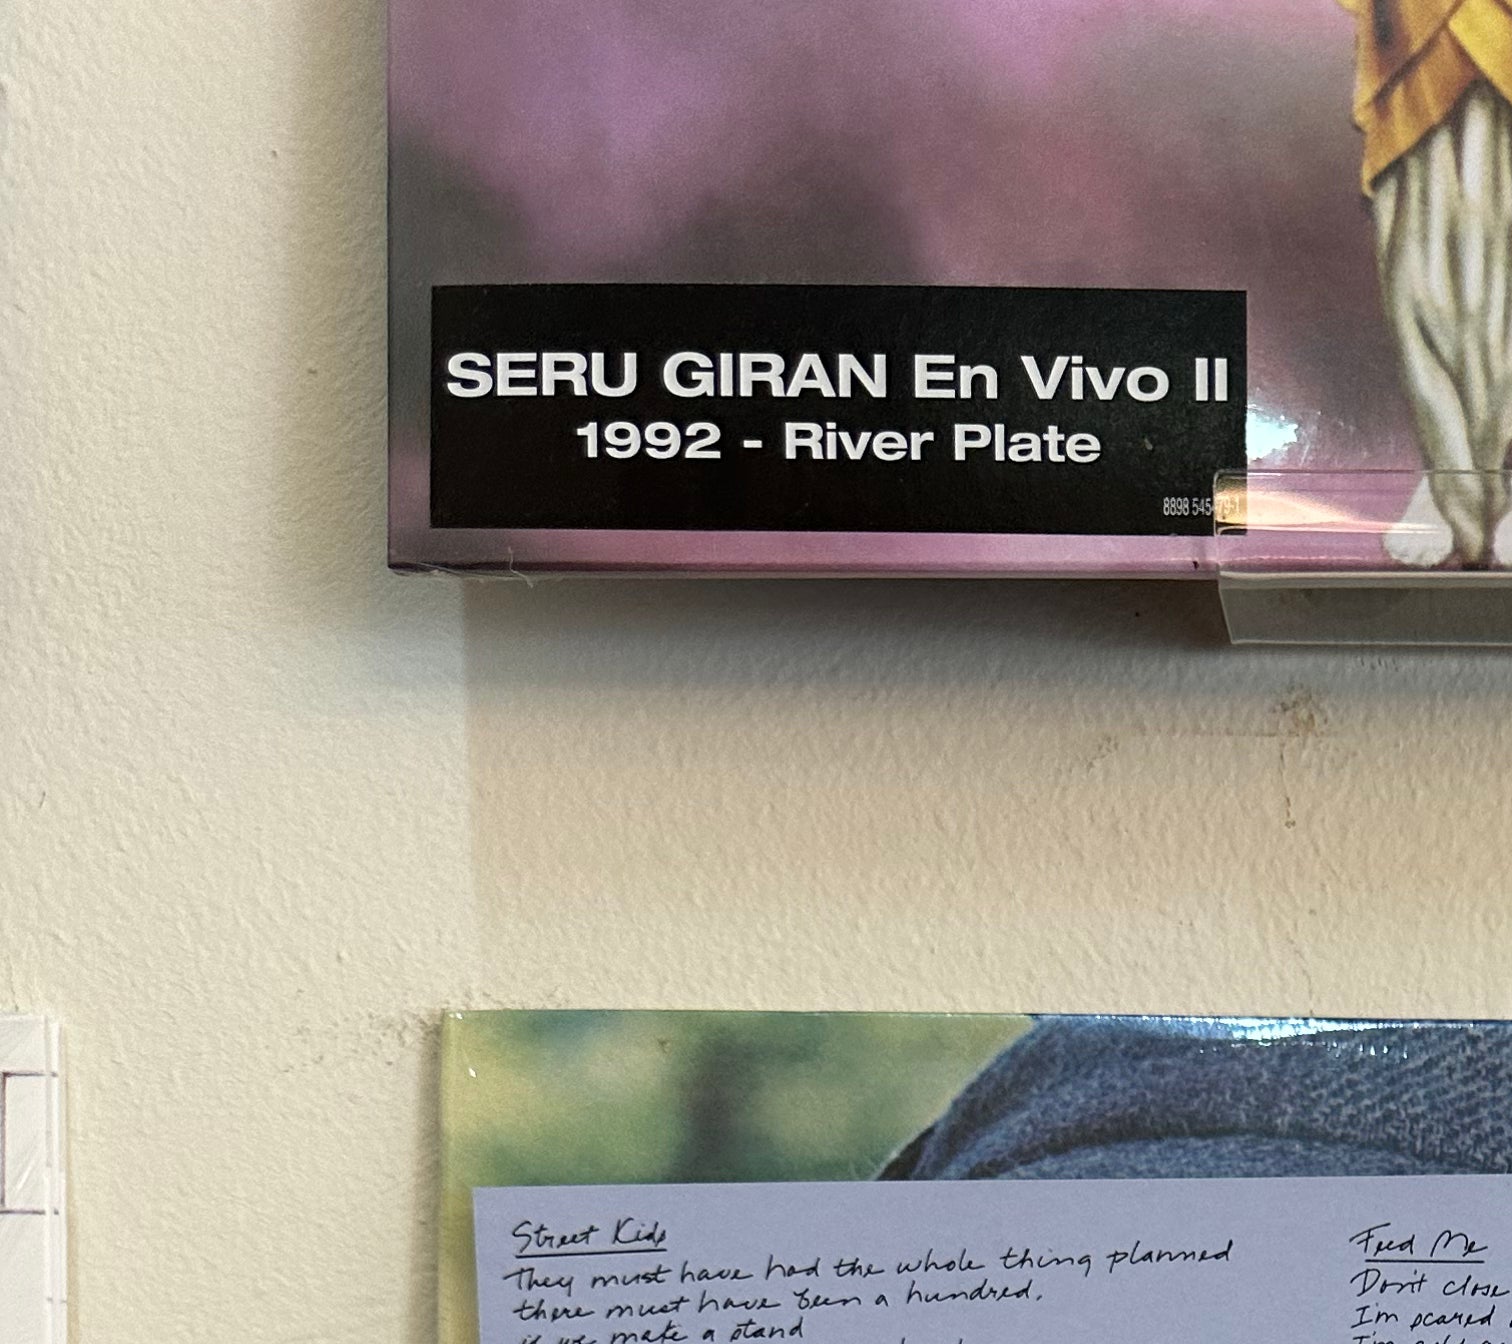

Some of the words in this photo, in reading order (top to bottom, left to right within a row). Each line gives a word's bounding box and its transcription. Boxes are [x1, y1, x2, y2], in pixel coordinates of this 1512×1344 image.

[446, 352, 637, 398] SERU
[663, 351, 887, 398] GIRAN
[914, 354, 998, 399] En
[1020, 355, 1169, 402] Vivo
[1195, 357, 1228, 402] II
[576, 421, 721, 459] 1992
[743, 439, 763, 449] -
[784, 421, 935, 461] River
[954, 423, 1101, 463] Plate
[1163, 497, 1190, 516] 8898
[1349, 1223, 1414, 1255] Feed
[1430, 1230, 1488, 1258] Me
[503, 1267, 574, 1296] They
[591, 1264, 672, 1289] must
[680, 1261, 754, 1284] have
[766, 1255, 819, 1280] had
[833, 1257, 884, 1278] the
[897, 1248, 985, 1275] whole
[1000, 1247, 1091, 1277] thing
[1106, 1239, 1233, 1274] planned
[1350, 1269, 1428, 1297] Don't
[1443, 1274, 1510, 1298] close
[1351, 1303, 1398, 1328] I'm
[1410, 1305, 1494, 1330] scared
